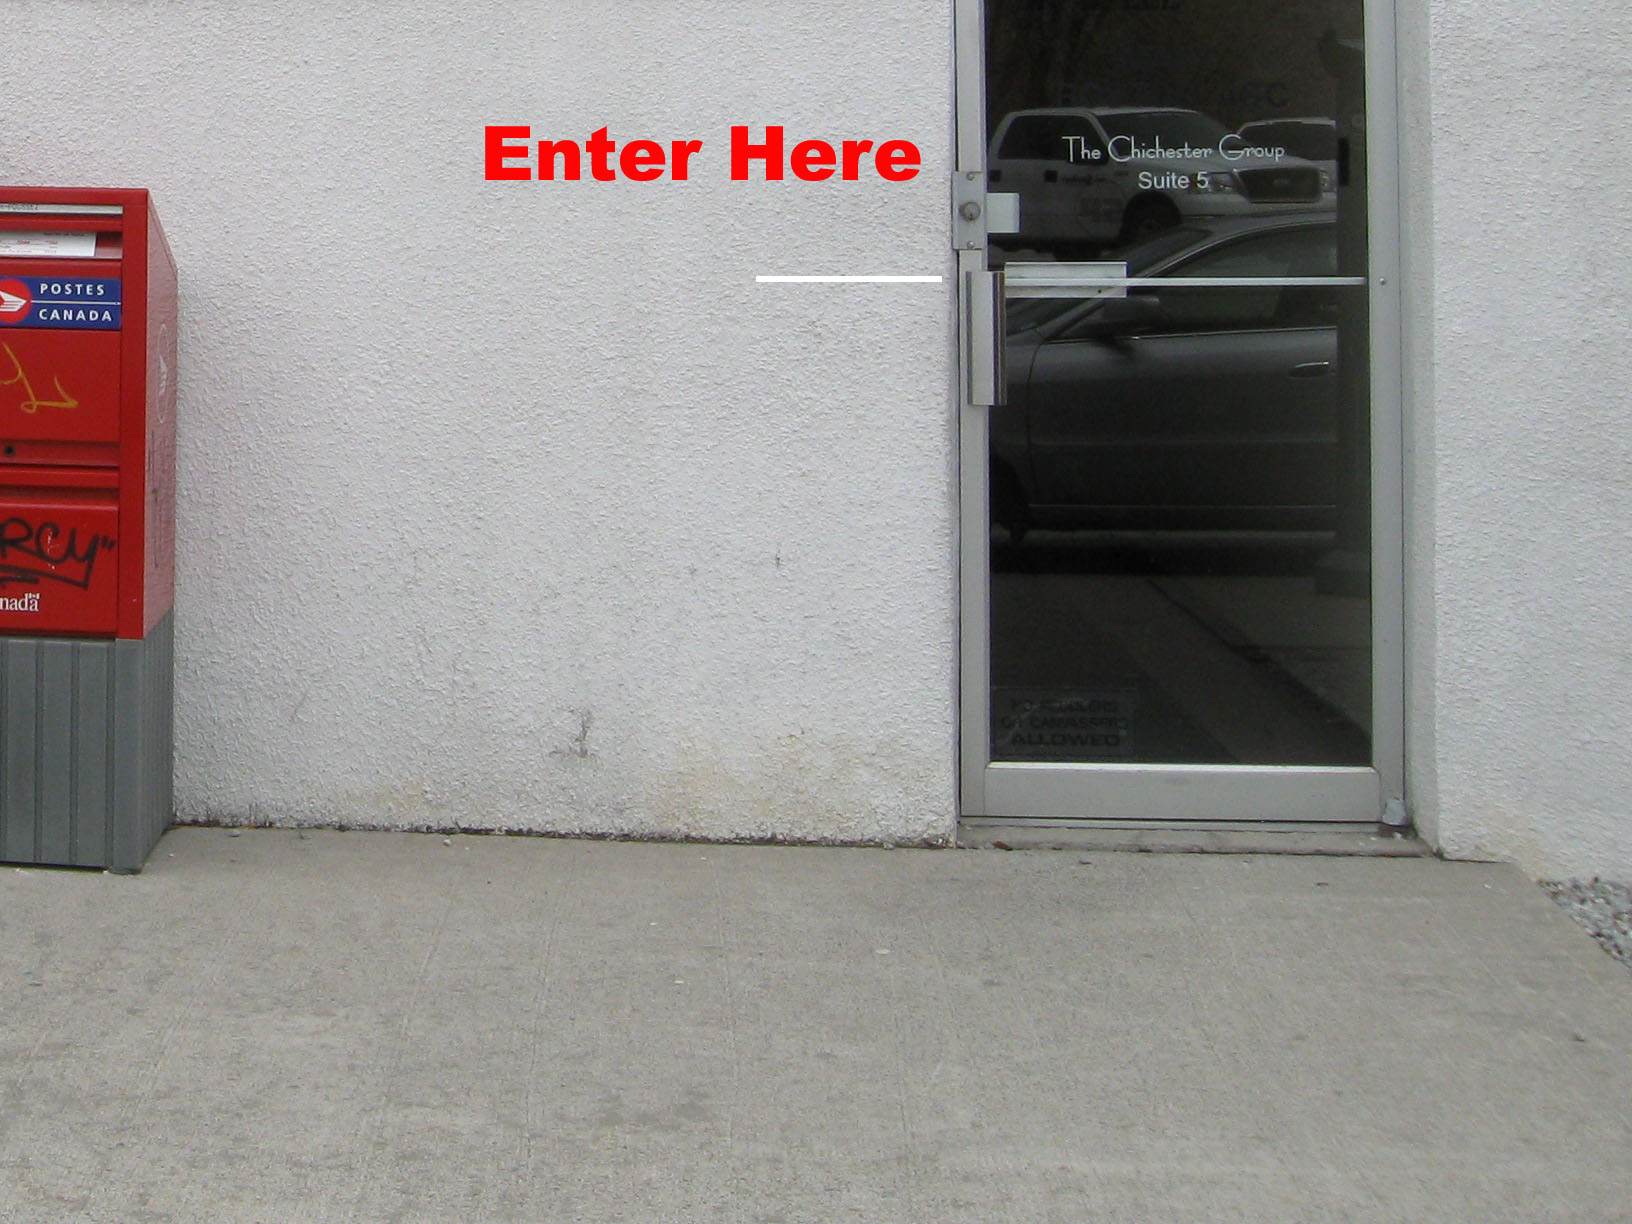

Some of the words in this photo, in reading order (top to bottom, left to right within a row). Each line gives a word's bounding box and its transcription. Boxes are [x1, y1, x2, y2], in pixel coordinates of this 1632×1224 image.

[1062, 135, 1101, 163] The
[1108, 135, 1213, 163] Chichester
[1219, 134, 1285, 163] Group
[1138, 171, 1190, 191] Suite
[1196, 172, 1209, 190] 5
[40, 283, 105, 296] POSTES
[38, 308, 112, 322] CANADA
